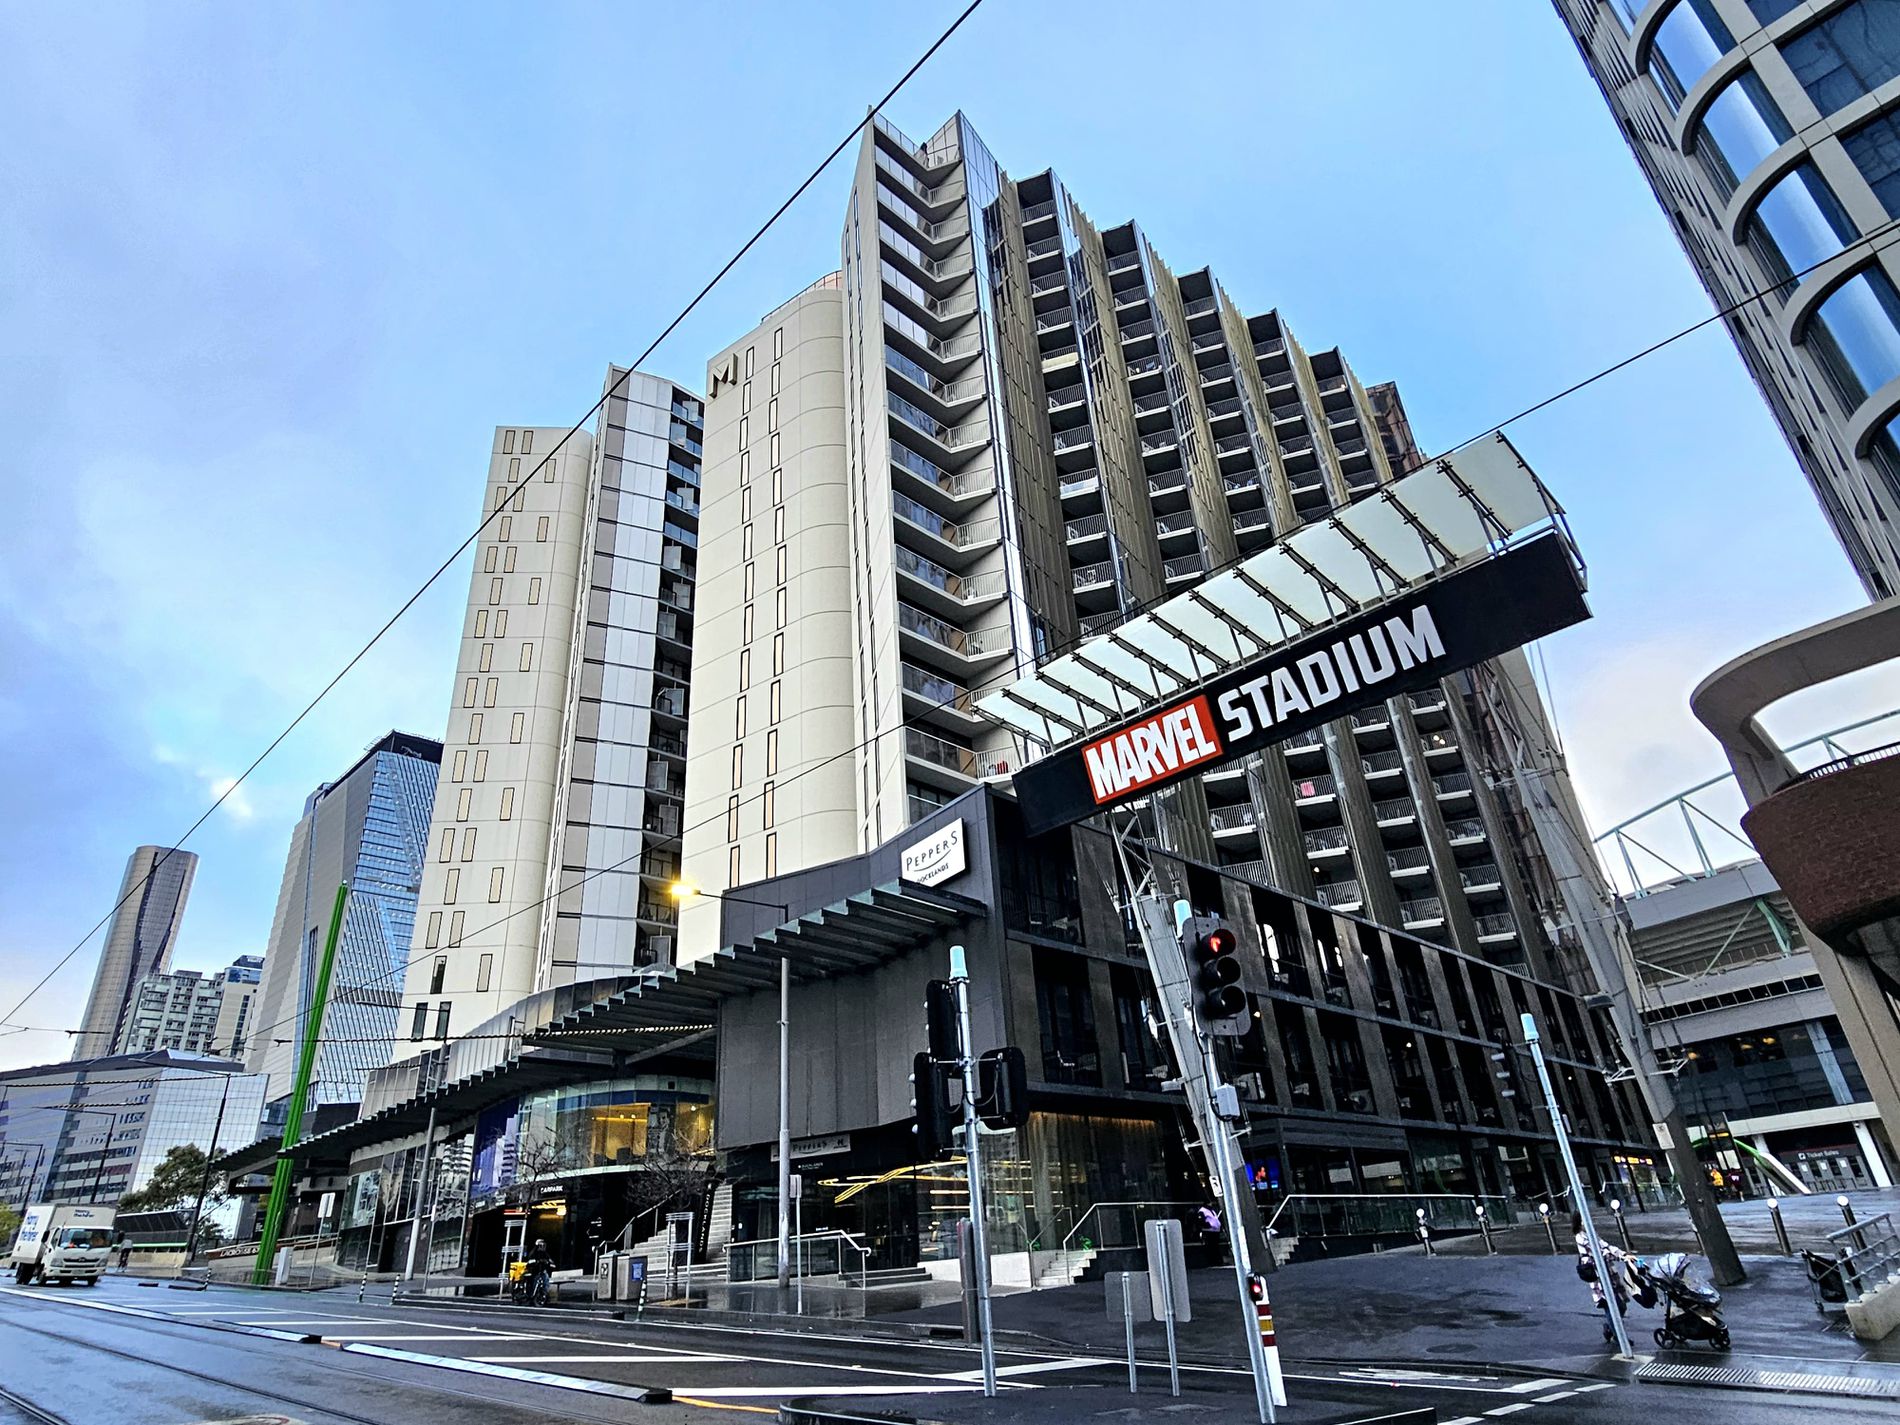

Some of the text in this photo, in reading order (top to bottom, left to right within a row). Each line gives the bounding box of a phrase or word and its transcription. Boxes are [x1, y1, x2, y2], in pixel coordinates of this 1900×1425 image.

[1085, 604, 1447, 800] MARVEL STADIUM
[906, 830, 958, 871] PEPPERS
